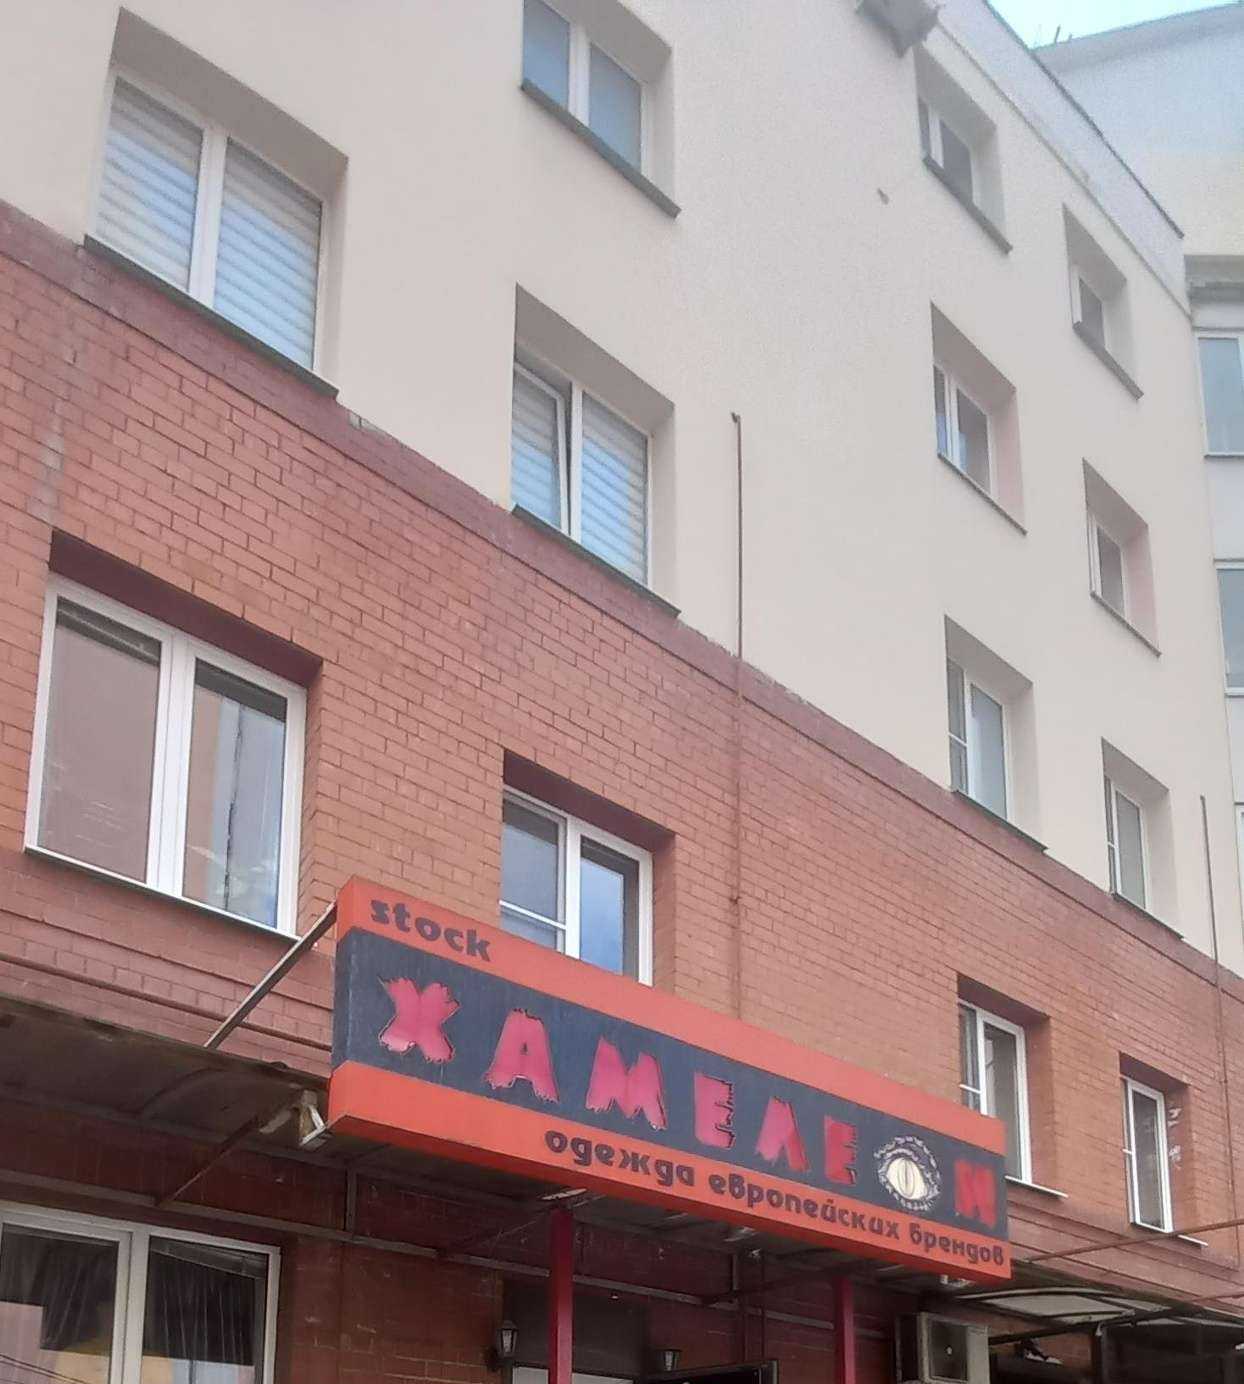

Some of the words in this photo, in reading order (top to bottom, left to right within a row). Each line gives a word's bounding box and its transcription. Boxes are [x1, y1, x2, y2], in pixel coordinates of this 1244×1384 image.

[370, 899, 490, 962] stock
[545, 1130, 694, 1186] одежда
[708, 1173, 900, 1240] европейских
[909, 1222, 1004, 1266] брендов
